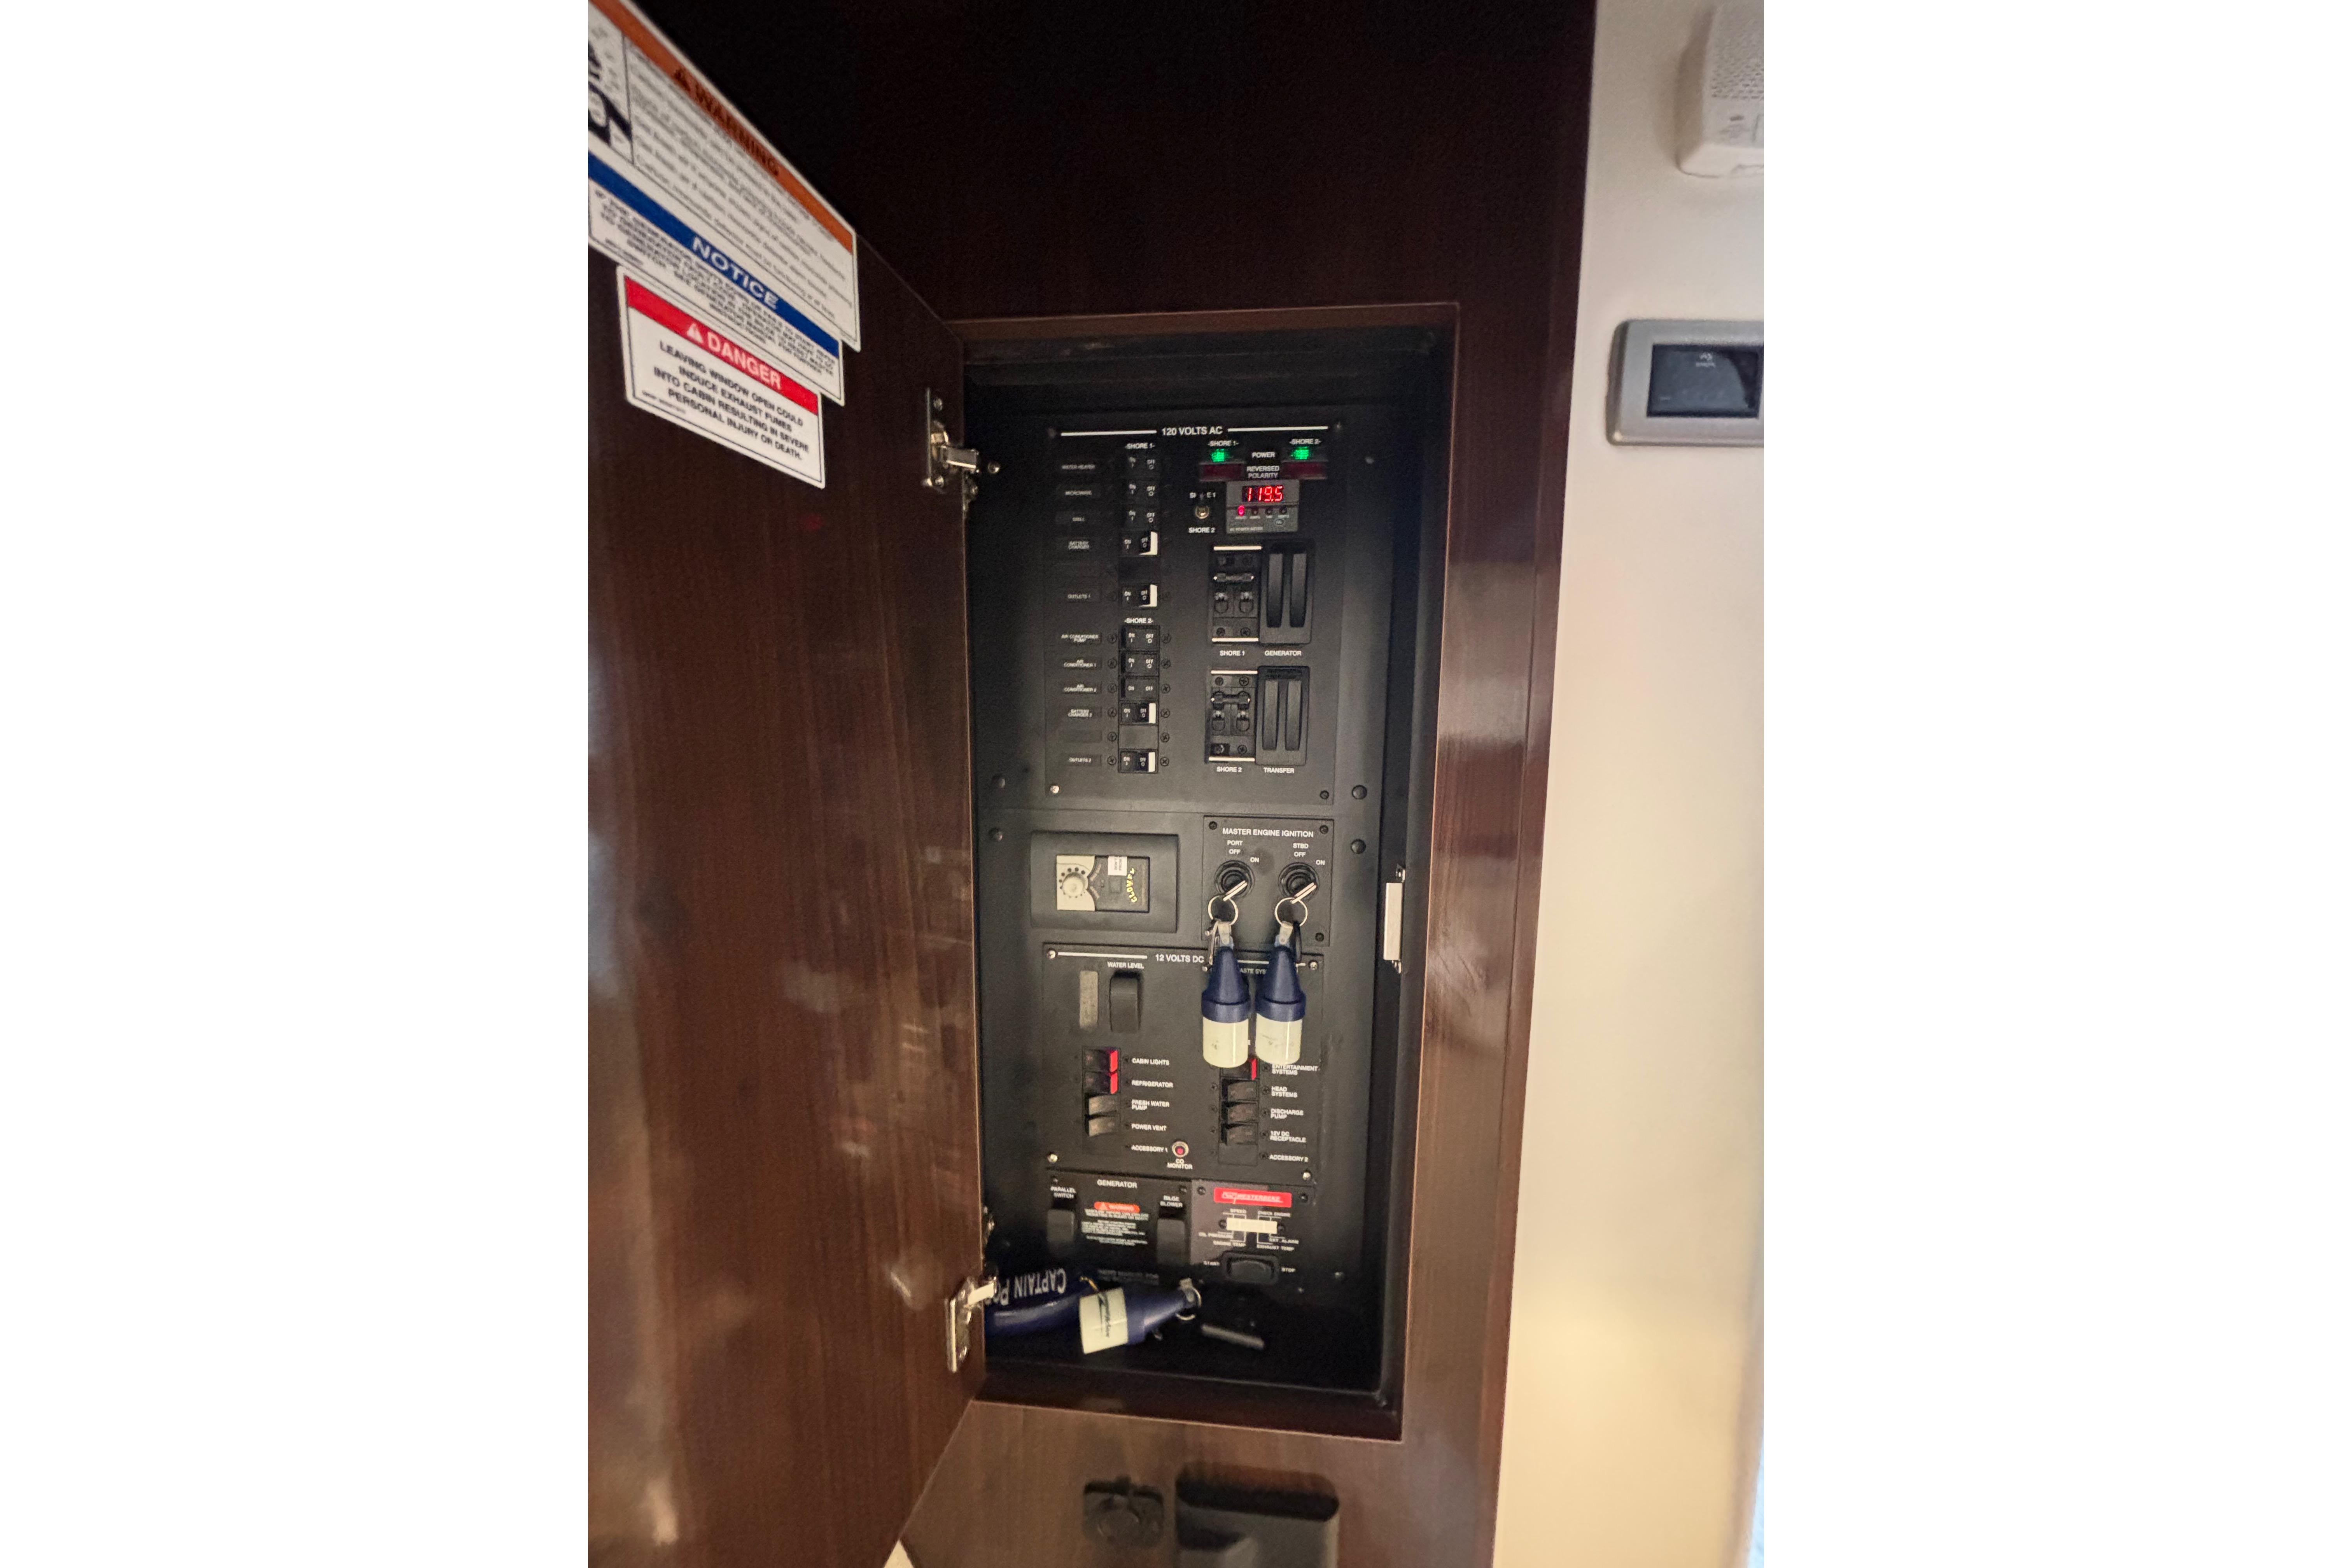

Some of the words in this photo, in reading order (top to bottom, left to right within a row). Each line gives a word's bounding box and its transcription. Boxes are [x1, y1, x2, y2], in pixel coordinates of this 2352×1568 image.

[693, 236, 779, 310] NOTICE
[660, 340, 707, 373] LEAVING
[709, 369, 749, 397] WINDOW
[752, 393, 775, 411] OPEN
[777, 405, 803, 427] COULD
[707, 331, 781, 389] DANGER
[654, 366, 680, 387] INTO
[683, 382, 715, 405] CABIN
[718, 400, 768, 432] RESULTING
[770, 427, 777, 436] IN
[780, 432, 809, 452] SEVERE
[668, 388, 724, 423] PERSONAL
[727, 417, 758, 439] INJURY
[761, 434, 772, 445] OR
[679, 366, 718, 392] INDUCE
[721, 388, 762, 418] EXHAUST
[765, 412, 791, 432] FUMES
[1179, 427, 1207, 435] VOLTS
[1209, 426, 1223, 434] AC
[1247, 486, 1284, 502] 119.5
[1155, 954, 1165, 962] 12
[1166, 954, 1188, 963] VOLTS
[1190, 955, 1204, 963] DC
[1097, 1179, 1137, 1188] GENERATOR
[1014, 1267, 1067, 1298] CAPTAIN
